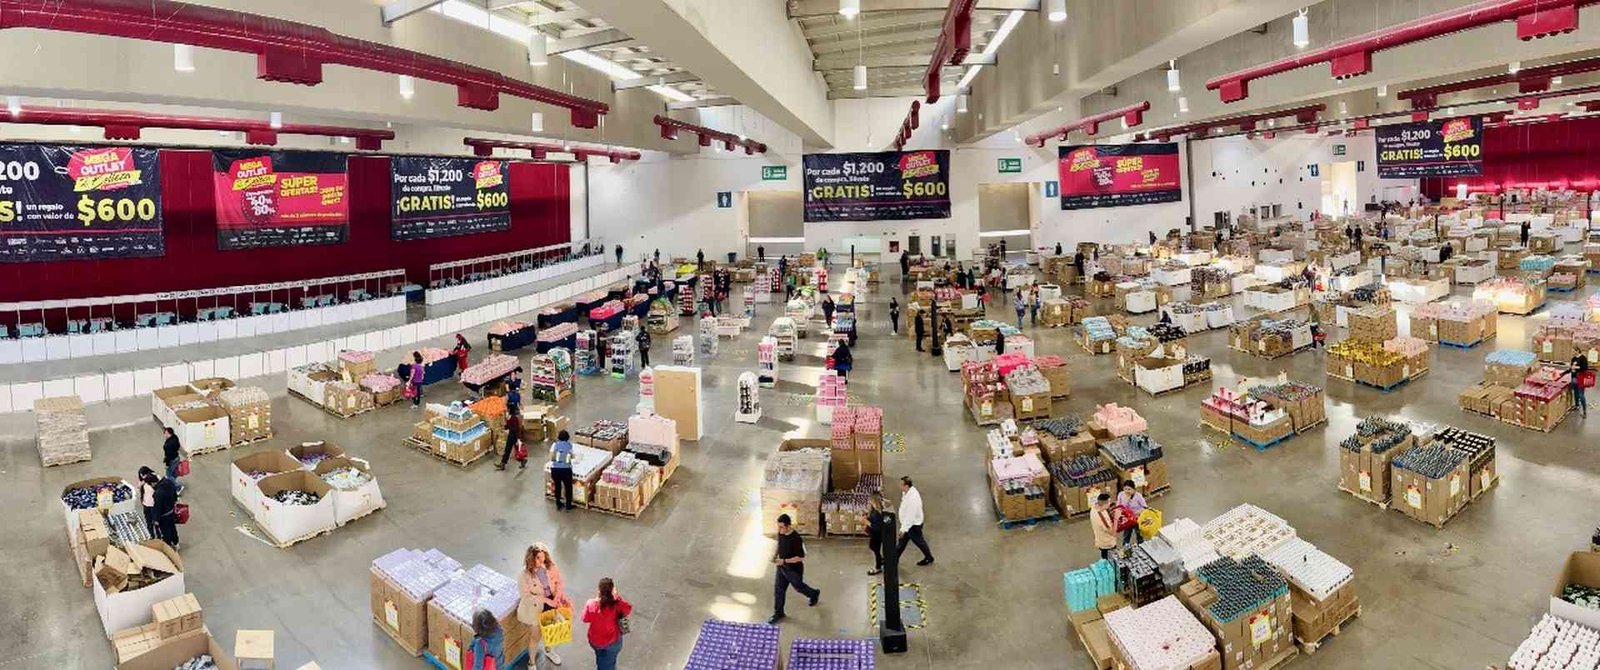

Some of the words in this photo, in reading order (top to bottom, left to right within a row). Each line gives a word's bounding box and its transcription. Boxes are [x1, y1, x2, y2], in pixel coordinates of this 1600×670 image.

[84, 152, 119, 165] MEGA
[1444, 143, 1480, 160] $600
[81, 160, 126, 175] OUTLET
[236, 167, 267, 178] OUTLET
[240, 161, 263, 170] MEGA
[821, 167, 840, 175] cada
[843, 161, 884, 176] $1,200
[281, 175, 317, 188] SÚPER
[394, 174, 407, 183] Por
[408, 173, 426, 183] cada
[428, 167, 463, 184] $1,200
[808, 185, 874, 201] ¡GRATIS!
[903, 180, 946, 199] $600
[396, 195, 455, 215] ¡GRATIS!
[477, 189, 508, 210] $600
[0, 200, 23, 222] S!
[38, 203, 64, 212] regalo
[77, 194, 156, 226] $600
[43, 212, 63, 220] valor
[64, 212, 75, 220] de
